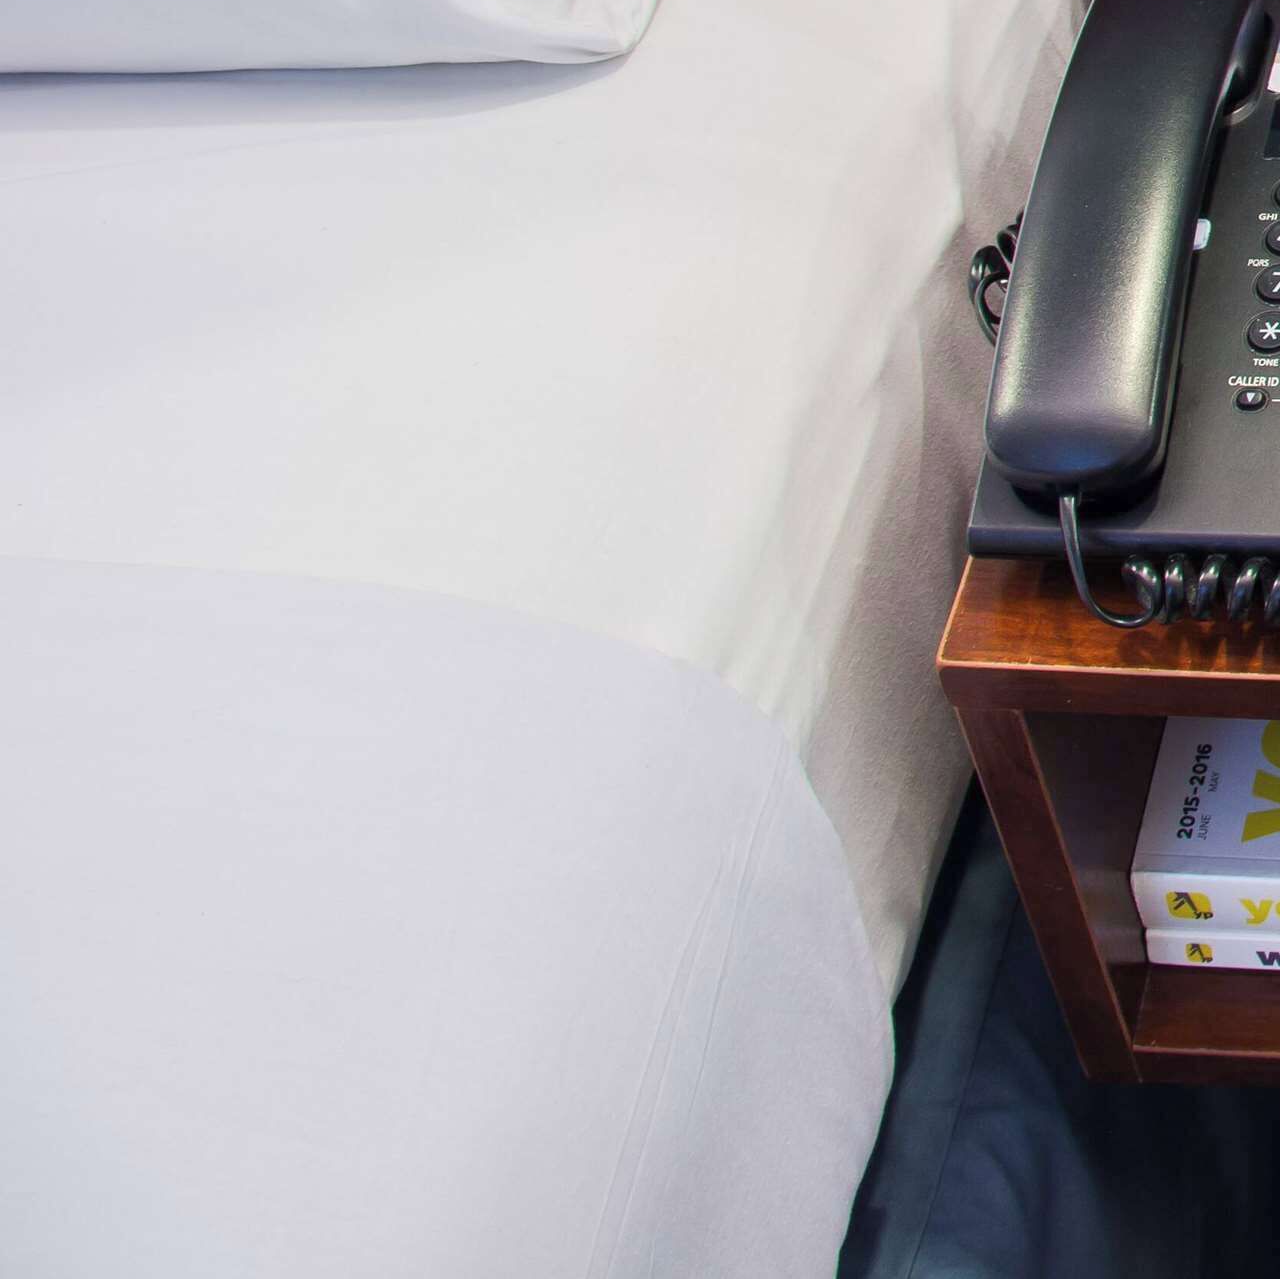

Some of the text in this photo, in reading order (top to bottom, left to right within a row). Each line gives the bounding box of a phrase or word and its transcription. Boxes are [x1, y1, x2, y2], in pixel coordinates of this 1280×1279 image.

[1258, 213, 1278, 221] GHI
[1247, 259, 1269, 267] PQRS
[1253, 358, 1279, 367] TONE
[1228, 376, 1279, 387] CALLER ID
[1177, 743, 1213, 839] 2015-2016
[1198, 771, 1220, 840] JUNE MAY
